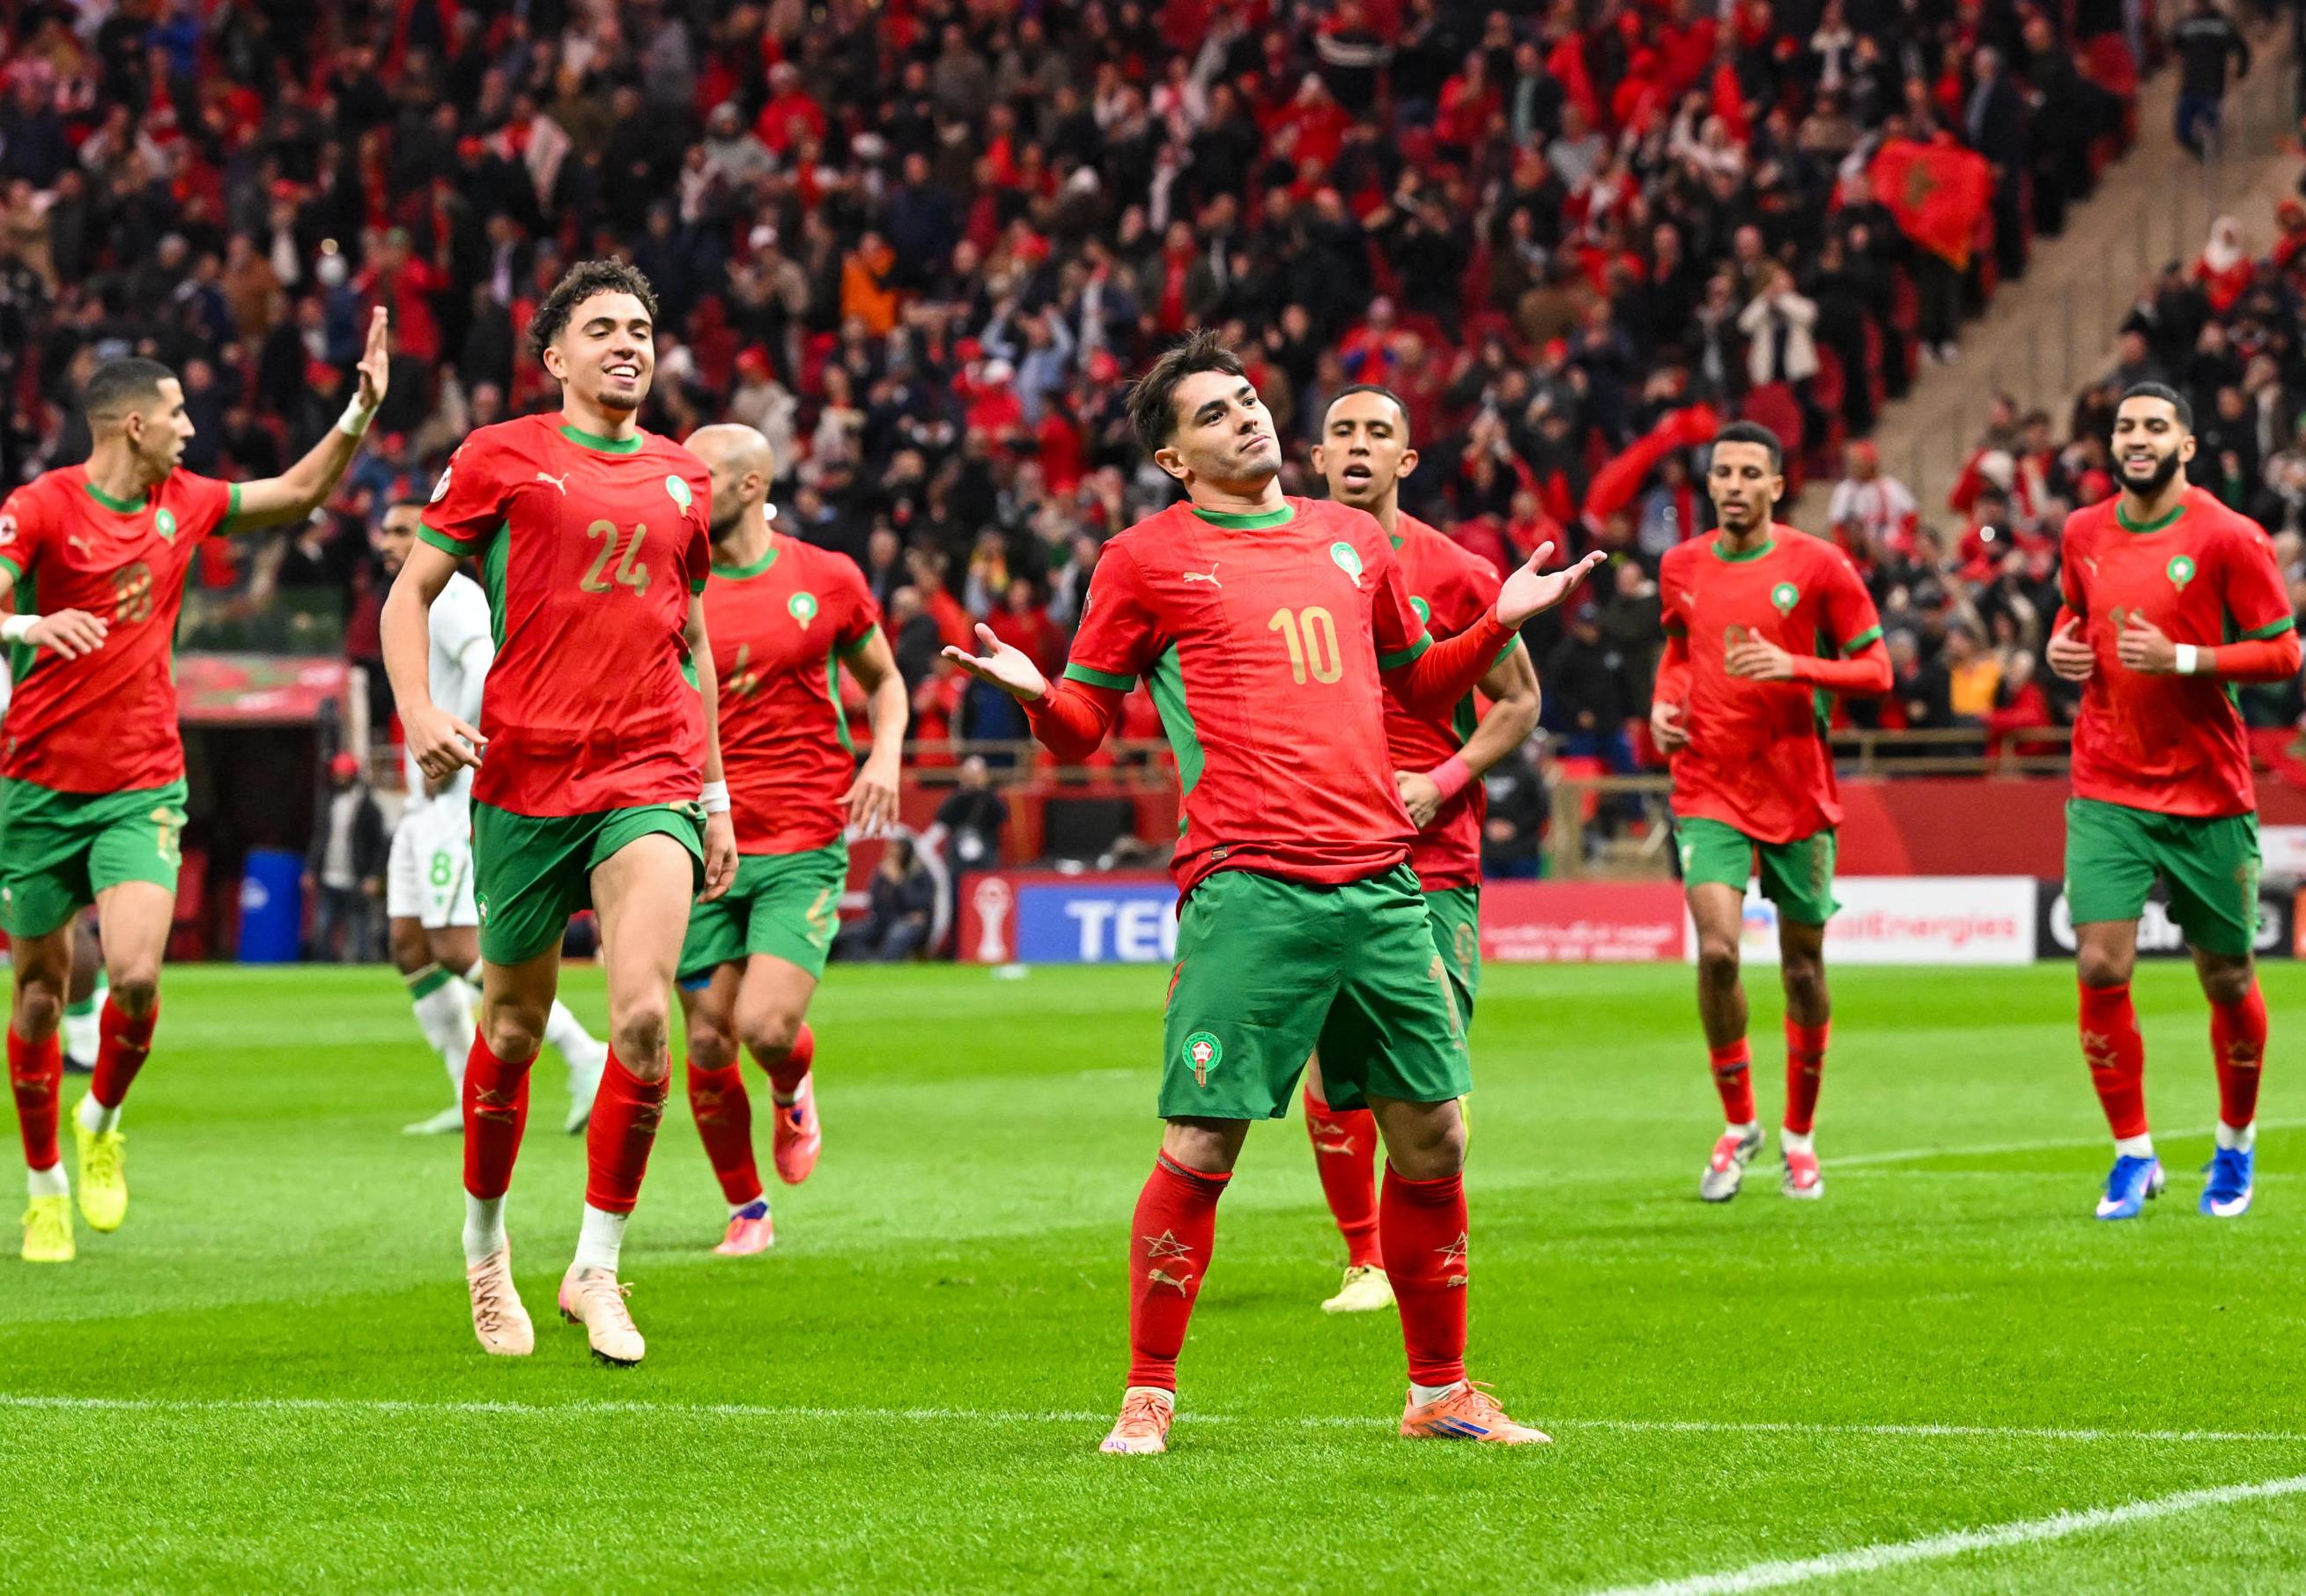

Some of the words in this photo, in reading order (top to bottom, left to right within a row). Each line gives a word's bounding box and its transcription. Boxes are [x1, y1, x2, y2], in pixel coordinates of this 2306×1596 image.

[580, 519, 651, 598] 24
[1268, 606, 1342, 684] 10
[430, 850, 452, 887] 8
[1428, 955, 1466, 1051] 1
